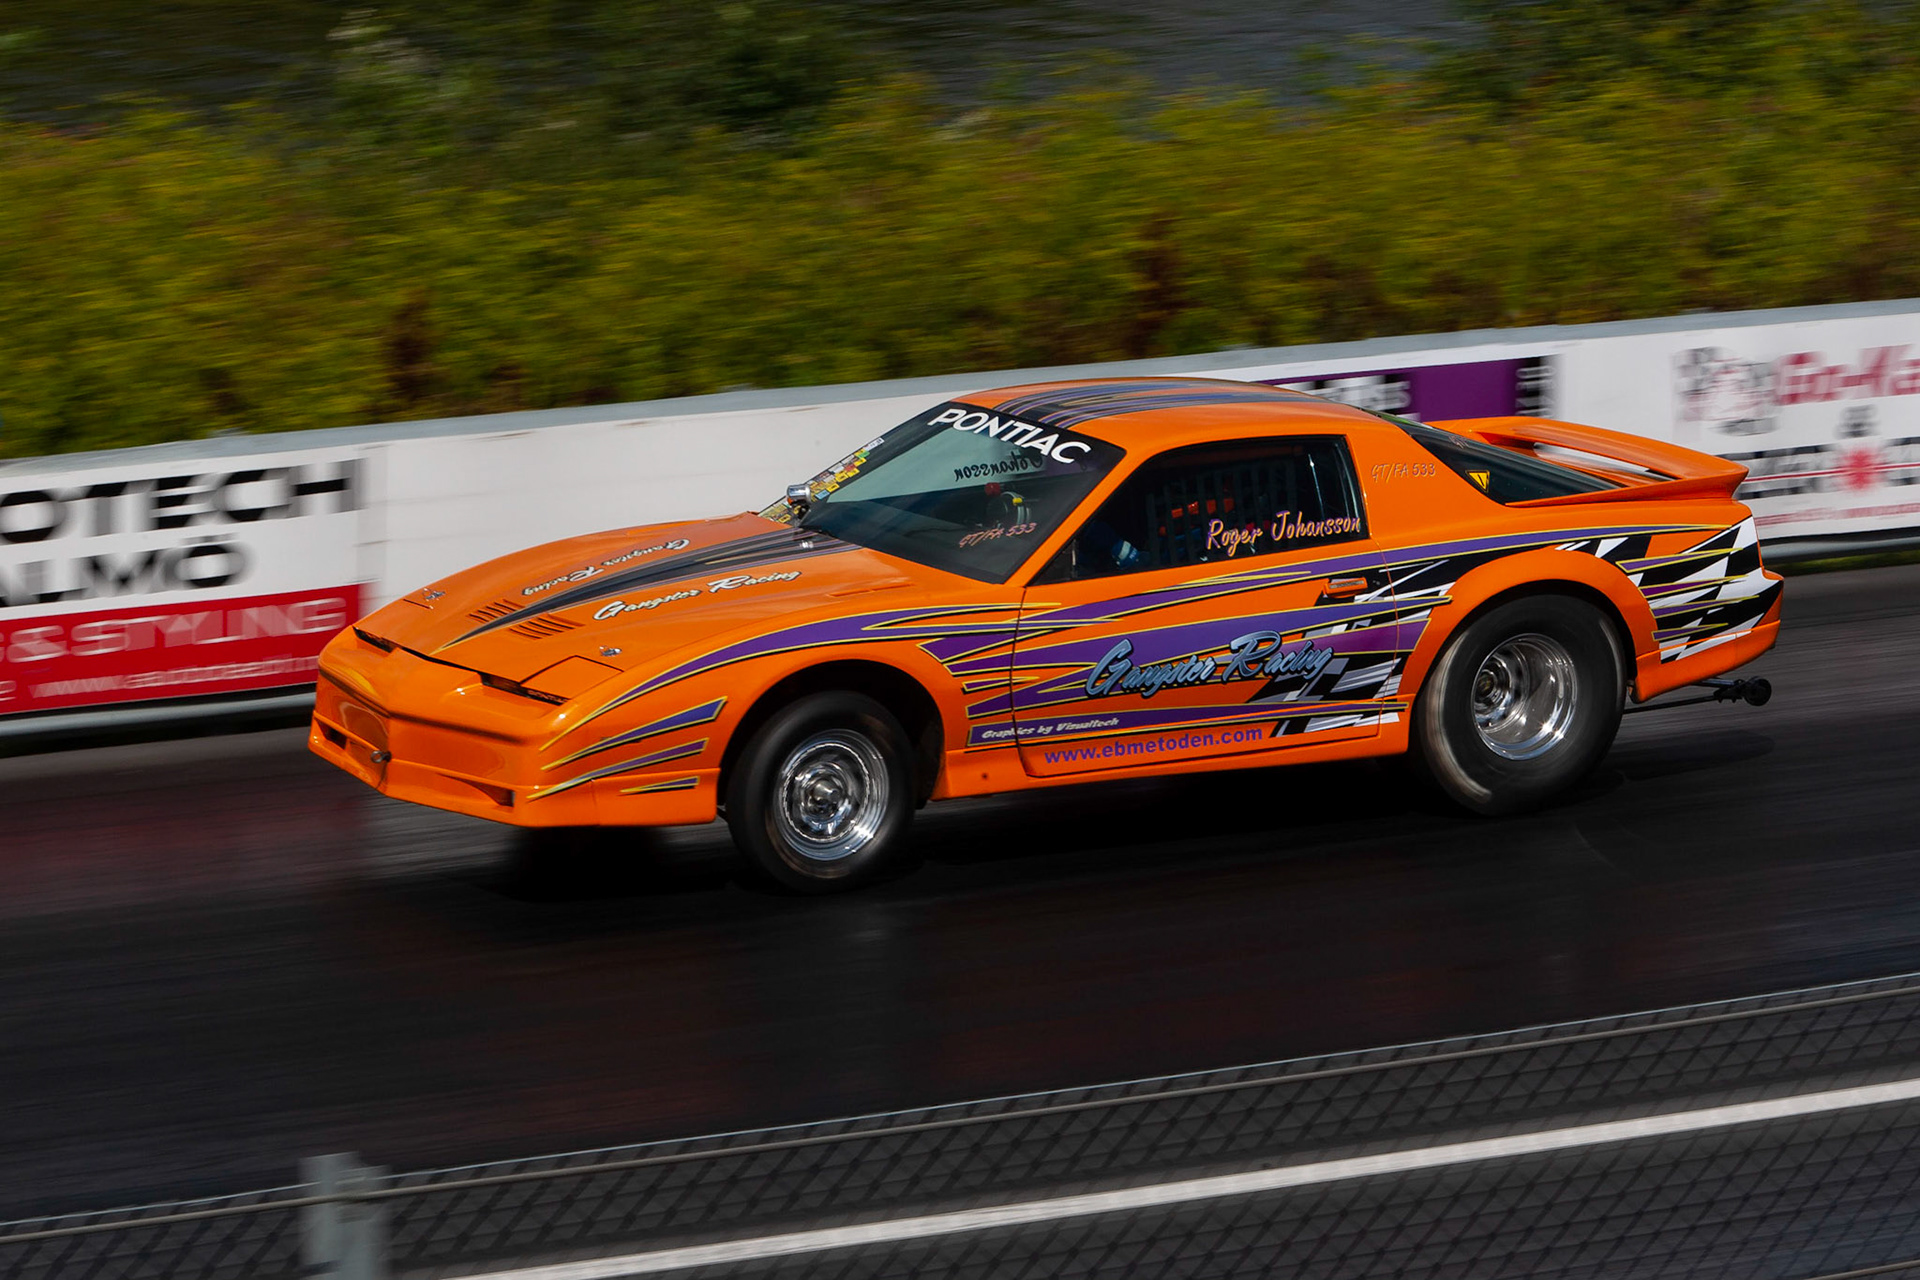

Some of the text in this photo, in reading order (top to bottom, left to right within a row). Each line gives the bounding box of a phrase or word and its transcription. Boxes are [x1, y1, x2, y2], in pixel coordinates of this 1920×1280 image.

[927, 408, 1092, 464] PONTIAC
[1371, 463, 1436, 483] GT/FA 533
[1006, 522, 1037, 537] 533
[1206, 510, 1360, 557] Roger Johansson
[521, 538, 691, 596] Gangster Racing
[592, 570, 802, 621] Gangster Racing
[1085, 631, 1335, 699] Gangster Racing
[981, 727, 1035, 739] Graphics
[1037, 725, 1054, 735] by
[1044, 725, 1263, 764] www.ebmetoden.com
